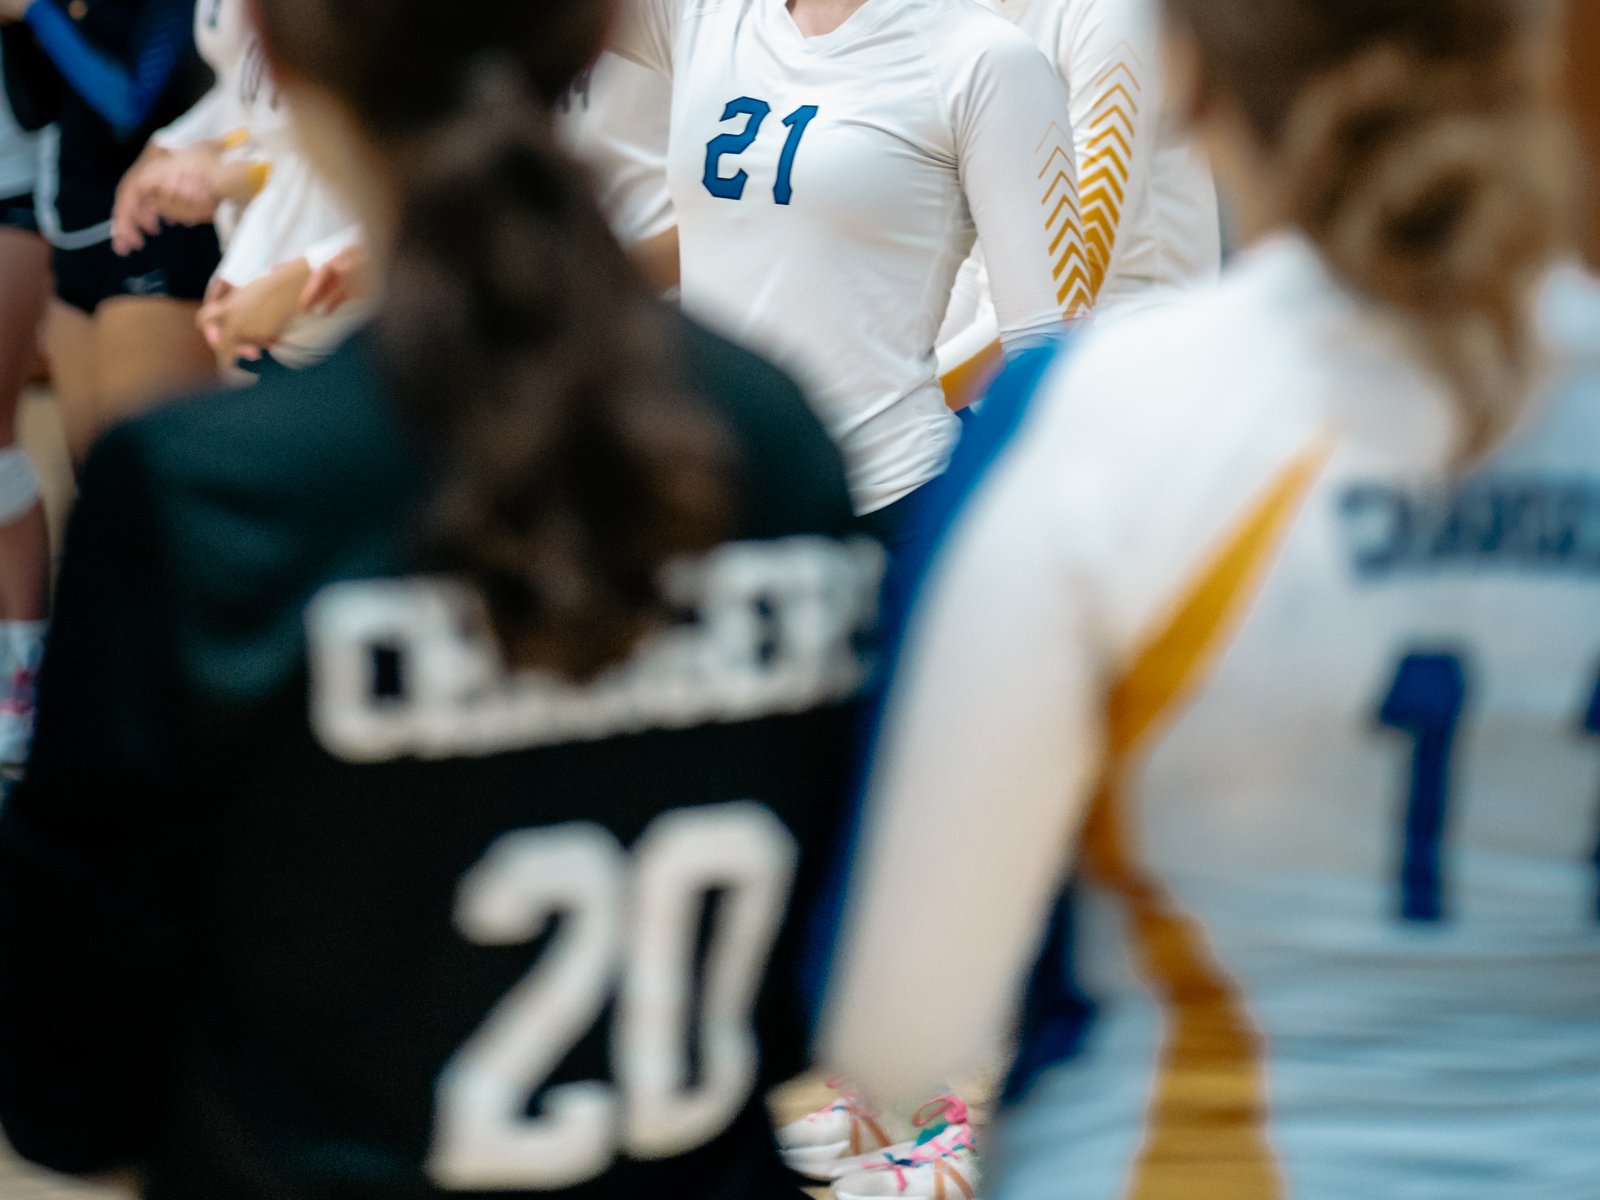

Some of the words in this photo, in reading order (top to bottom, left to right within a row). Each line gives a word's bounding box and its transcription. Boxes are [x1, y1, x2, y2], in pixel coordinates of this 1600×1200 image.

[702, 96, 819, 206] 21
[1378, 652, 1600, 924] 1
[429, 802, 797, 1189] 20
